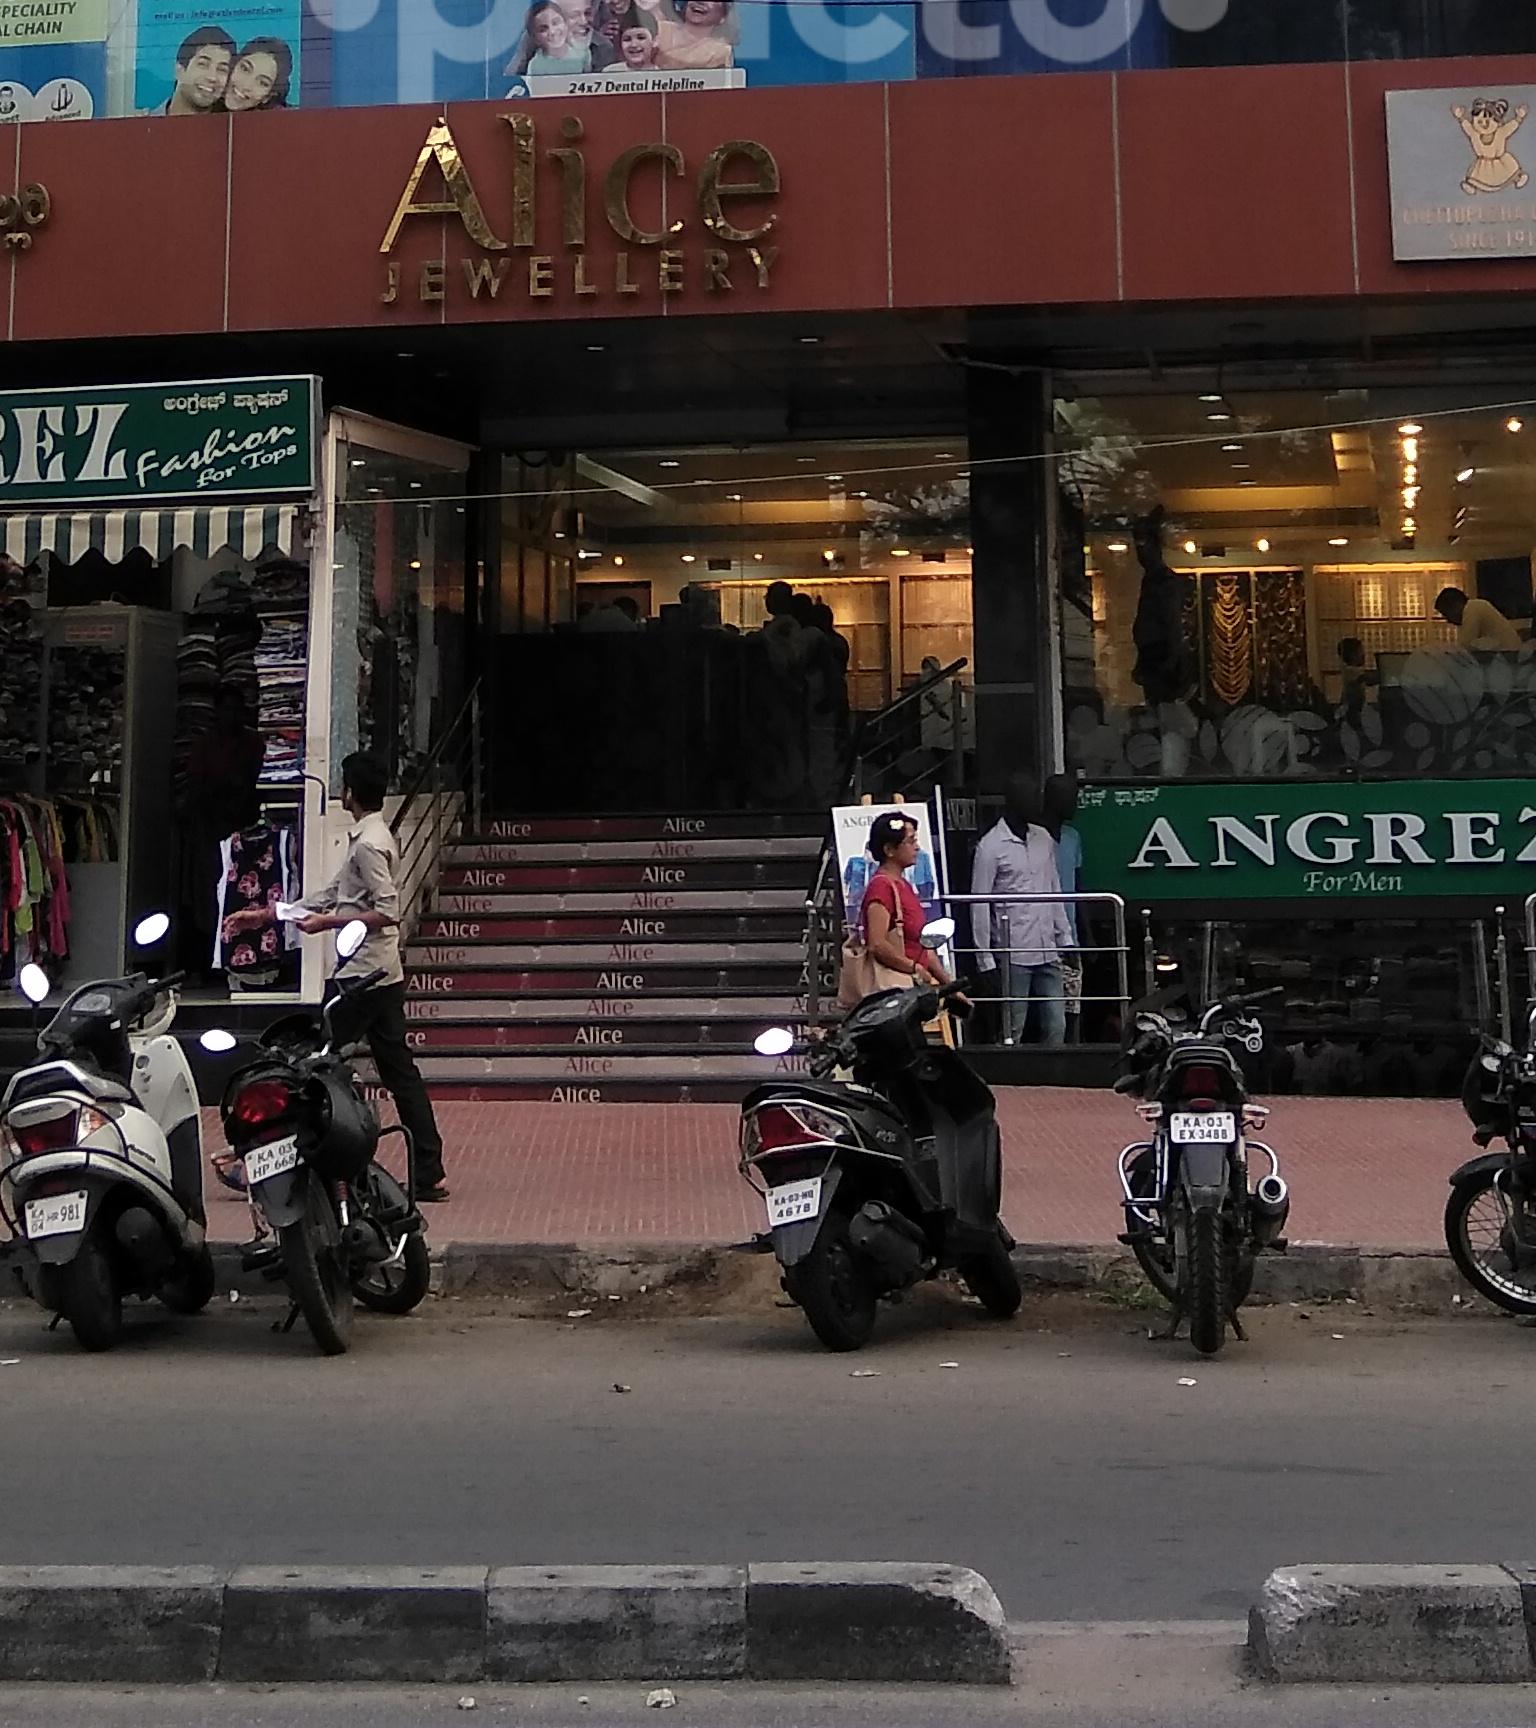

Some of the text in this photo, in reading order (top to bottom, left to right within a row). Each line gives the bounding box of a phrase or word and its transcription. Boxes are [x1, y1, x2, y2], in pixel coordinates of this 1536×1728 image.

[14, 21, 63, 36] CHAIN
[568, 76, 705, 95] 24x7 Dental Helpline
[379, 113, 781, 253] Alice
[381, 247, 781, 304] JEWELLERY
[136, 425, 297, 488] Fashion
[240, 444, 298, 470] Tops
[489, 820, 532, 838] Alice
[662, 817, 706, 834] Alice
[462, 869, 506, 887] Alice
[640, 866, 686, 885] Alice
[1303, 870, 1404, 893] For Men
[435, 920, 481, 938] Alice
[619, 918, 666, 936] Alice
[408, 973, 454, 992] Alice
[596, 971, 644, 989] Alice
[574, 1026, 624, 1045] Alice
[550, 1085, 602, 1104] Alice
[256, 1143, 293, 1164] KA 03
[60, 1202, 80, 1223] 981
